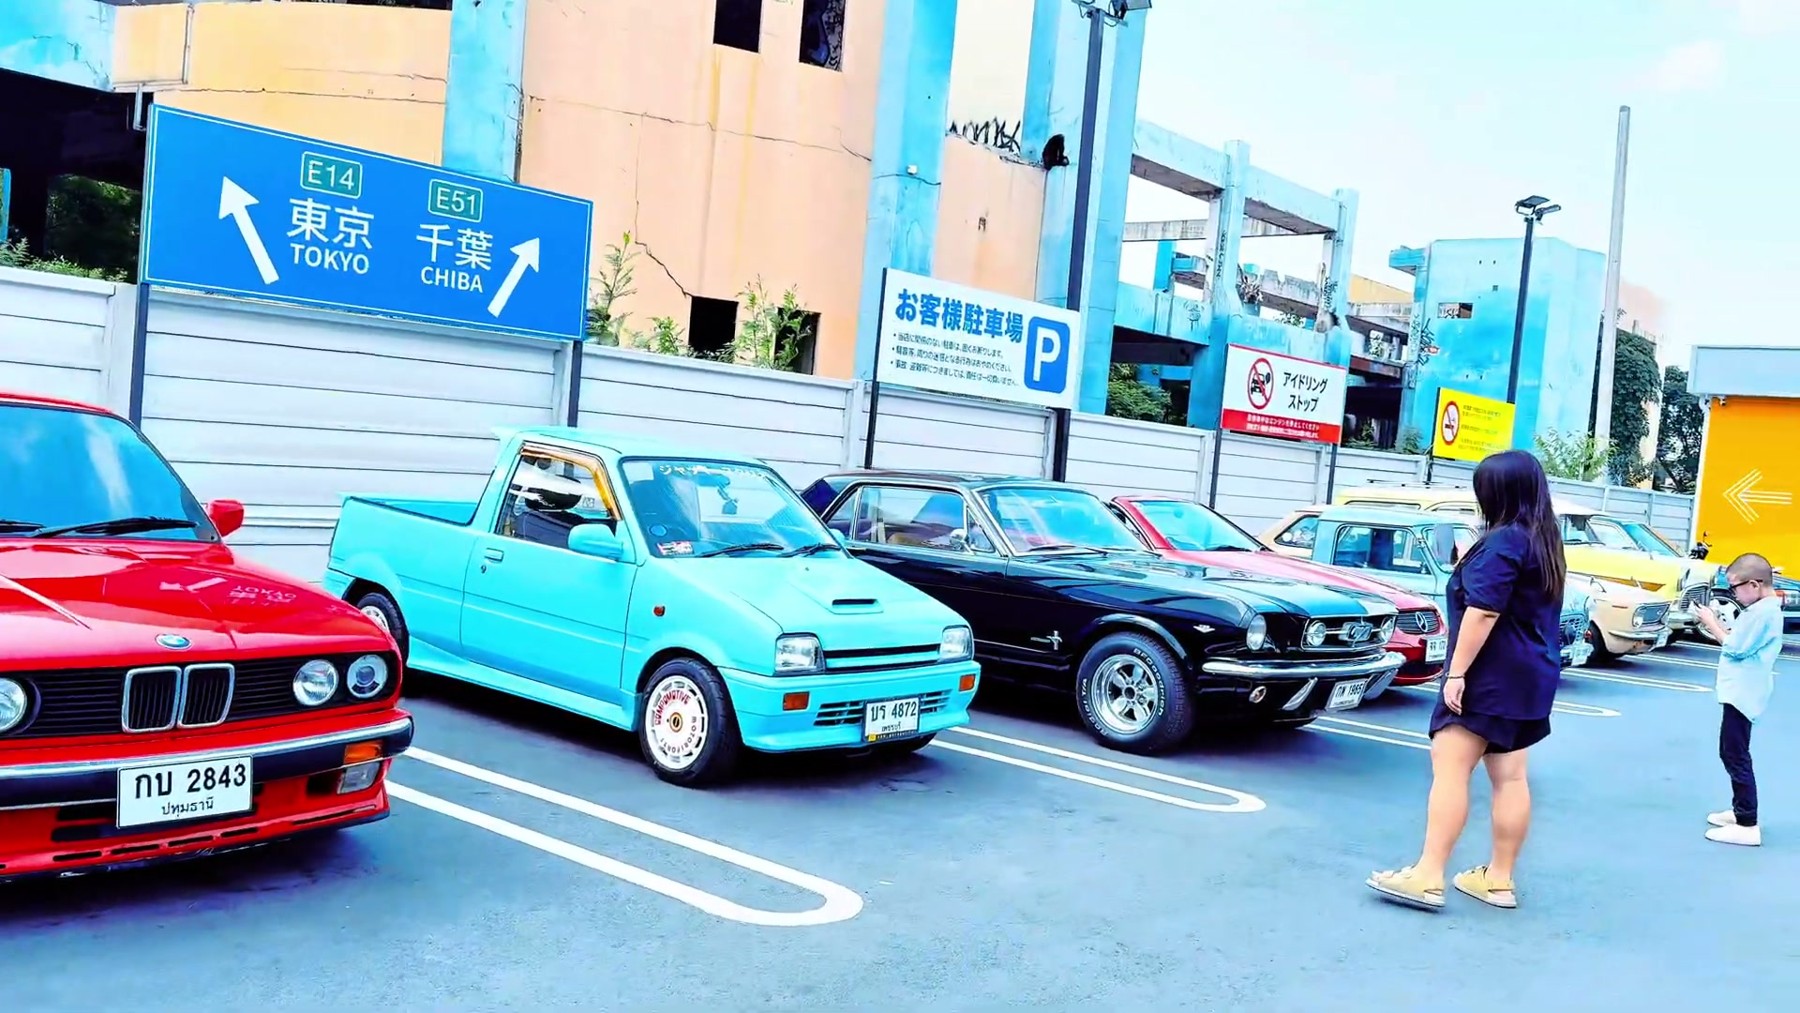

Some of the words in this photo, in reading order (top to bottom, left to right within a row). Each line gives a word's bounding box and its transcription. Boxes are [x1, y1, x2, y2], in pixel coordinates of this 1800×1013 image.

[307, 160, 355, 190] E14
[436, 188, 476, 215] E51
[286, 197, 375, 251] 東京
[290, 243, 370, 276] TOKYO
[416, 223, 494, 273] 千葉
[421, 265, 484, 294] CHIBA
[895, 288, 1024, 344] お客様駐車場
[1032, 326, 1061, 382] P
[1283, 371, 1329, 392] アイドリング
[1288, 395, 1319, 413] ストップ
[891, 701, 917, 719] 4872
[135, 770, 173, 800] กบ
[187, 763, 247, 794] 2843
[161, 796, 215, 818] ปทุมธานี
